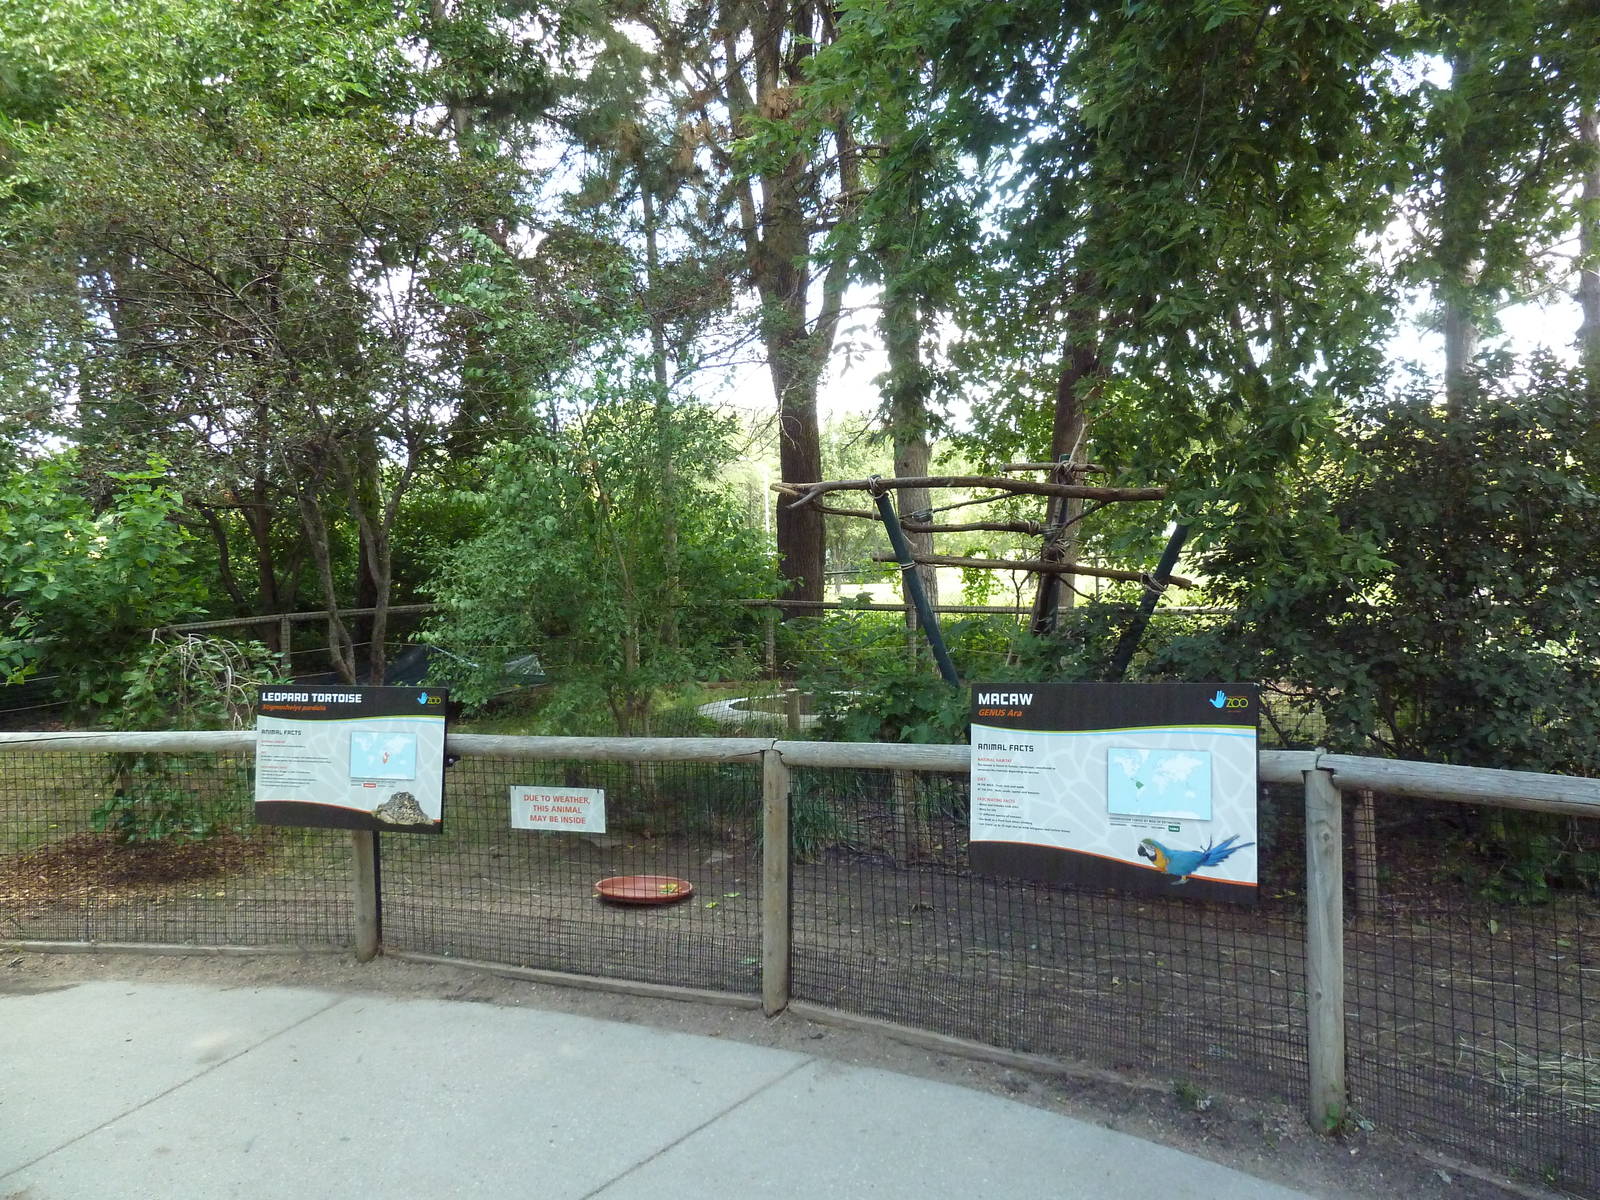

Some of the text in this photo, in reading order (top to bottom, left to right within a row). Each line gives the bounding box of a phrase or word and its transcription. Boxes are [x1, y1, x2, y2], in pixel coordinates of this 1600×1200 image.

[262, 692, 362, 703] LEOPARD TORTOISE
[978, 693, 1033, 705] MACAW
[1226, 698, 1249, 708] ZOO
[978, 708, 1023, 717] GENUS Ara
[977, 743, 1007, 751] ANIMAL
[523, 794, 539, 802] DUE
[552, 795, 591, 804] WEATHER,
[561, 816, 586, 824] INSIDE
